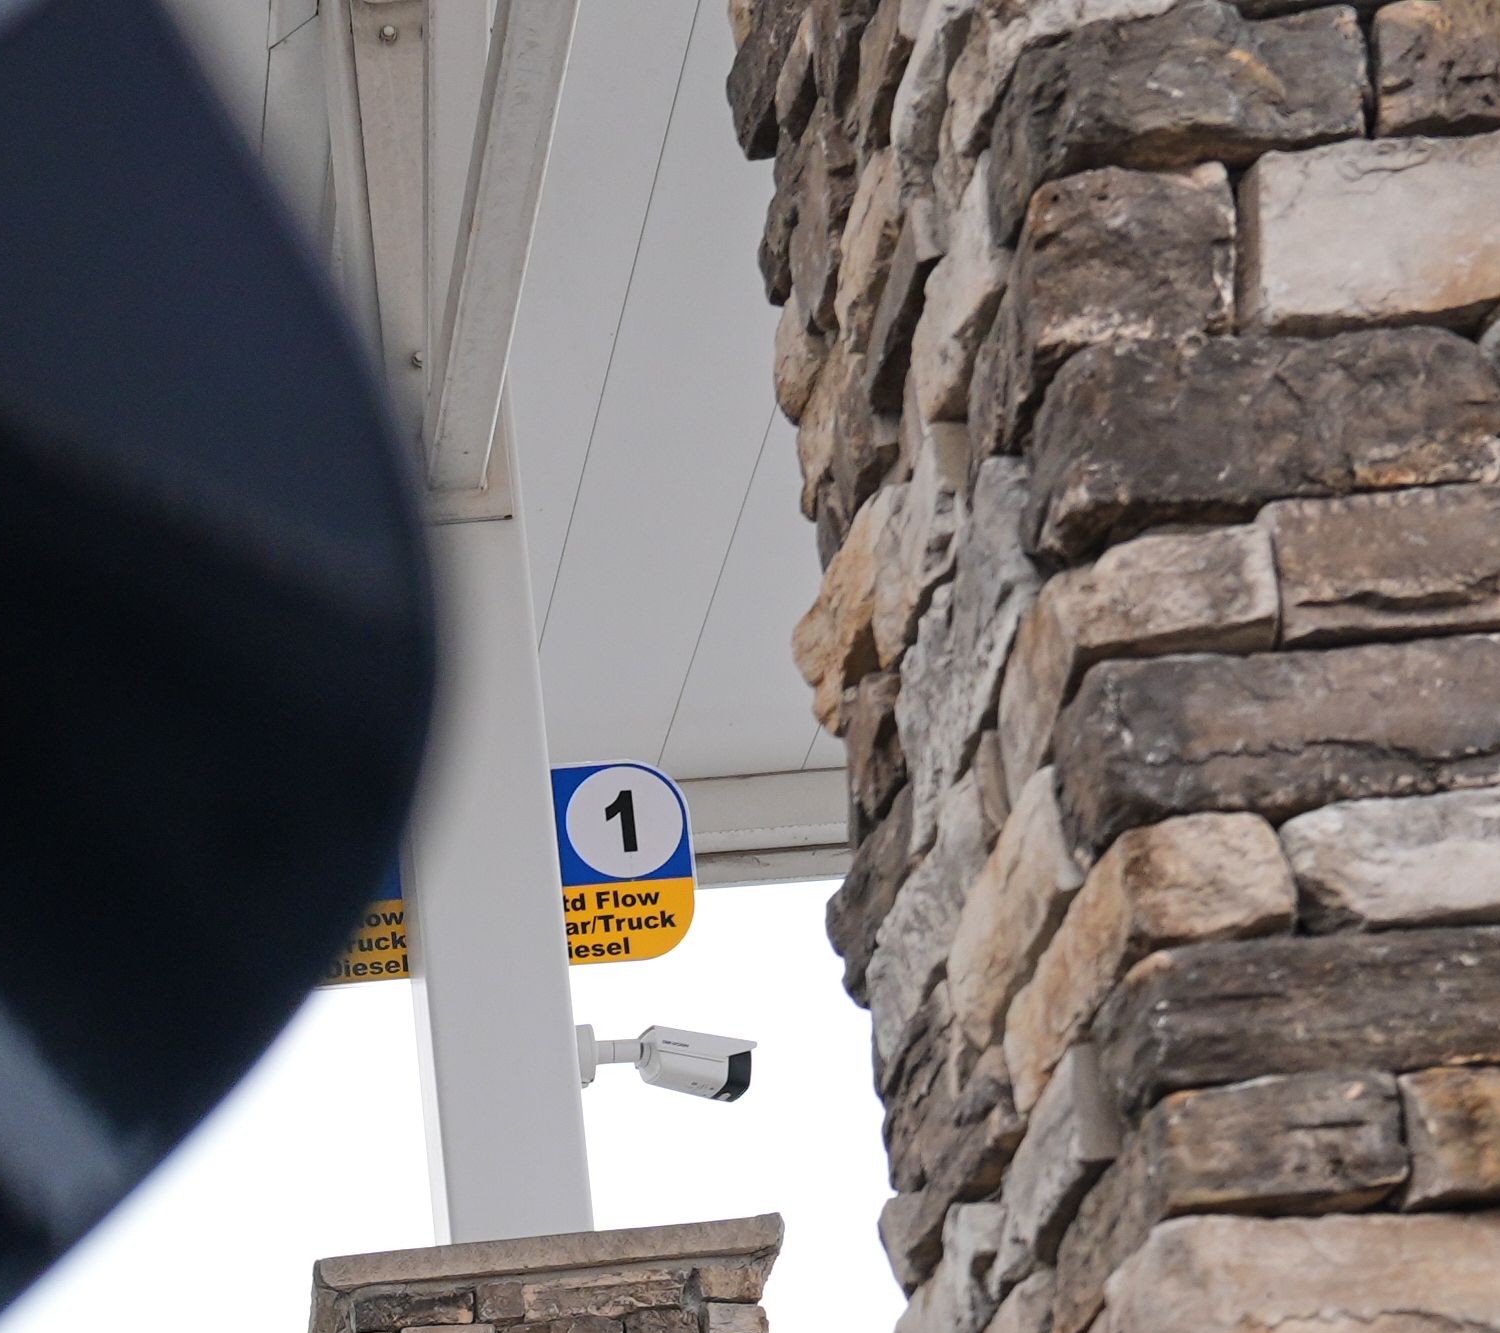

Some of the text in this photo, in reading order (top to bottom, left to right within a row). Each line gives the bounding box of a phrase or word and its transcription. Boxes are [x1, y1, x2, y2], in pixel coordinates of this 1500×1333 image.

[604, 789, 639, 853] 1
[595, 889, 661, 910] Flow
[565, 910, 677, 936] ar/Truck
[567, 936, 631, 960] iesel
